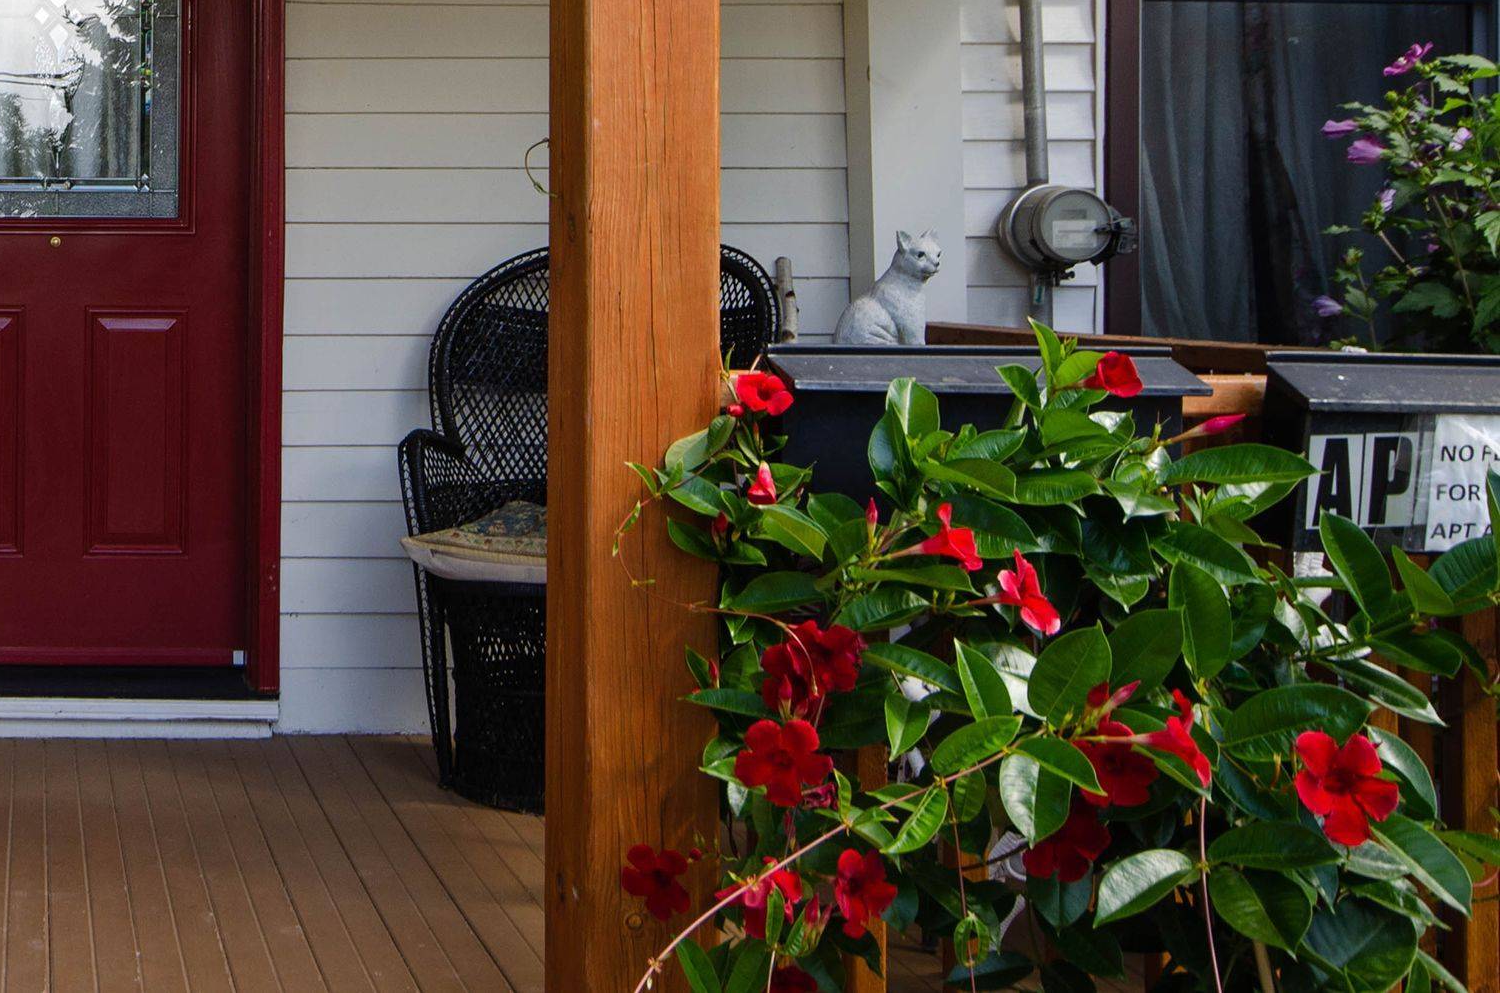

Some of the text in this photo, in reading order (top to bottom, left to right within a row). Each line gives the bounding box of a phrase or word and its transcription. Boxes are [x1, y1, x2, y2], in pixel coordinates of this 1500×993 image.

[1440, 444, 1475, 462] NO
[1436, 484, 1481, 501] FOR
[1430, 523, 1477, 539] APT
